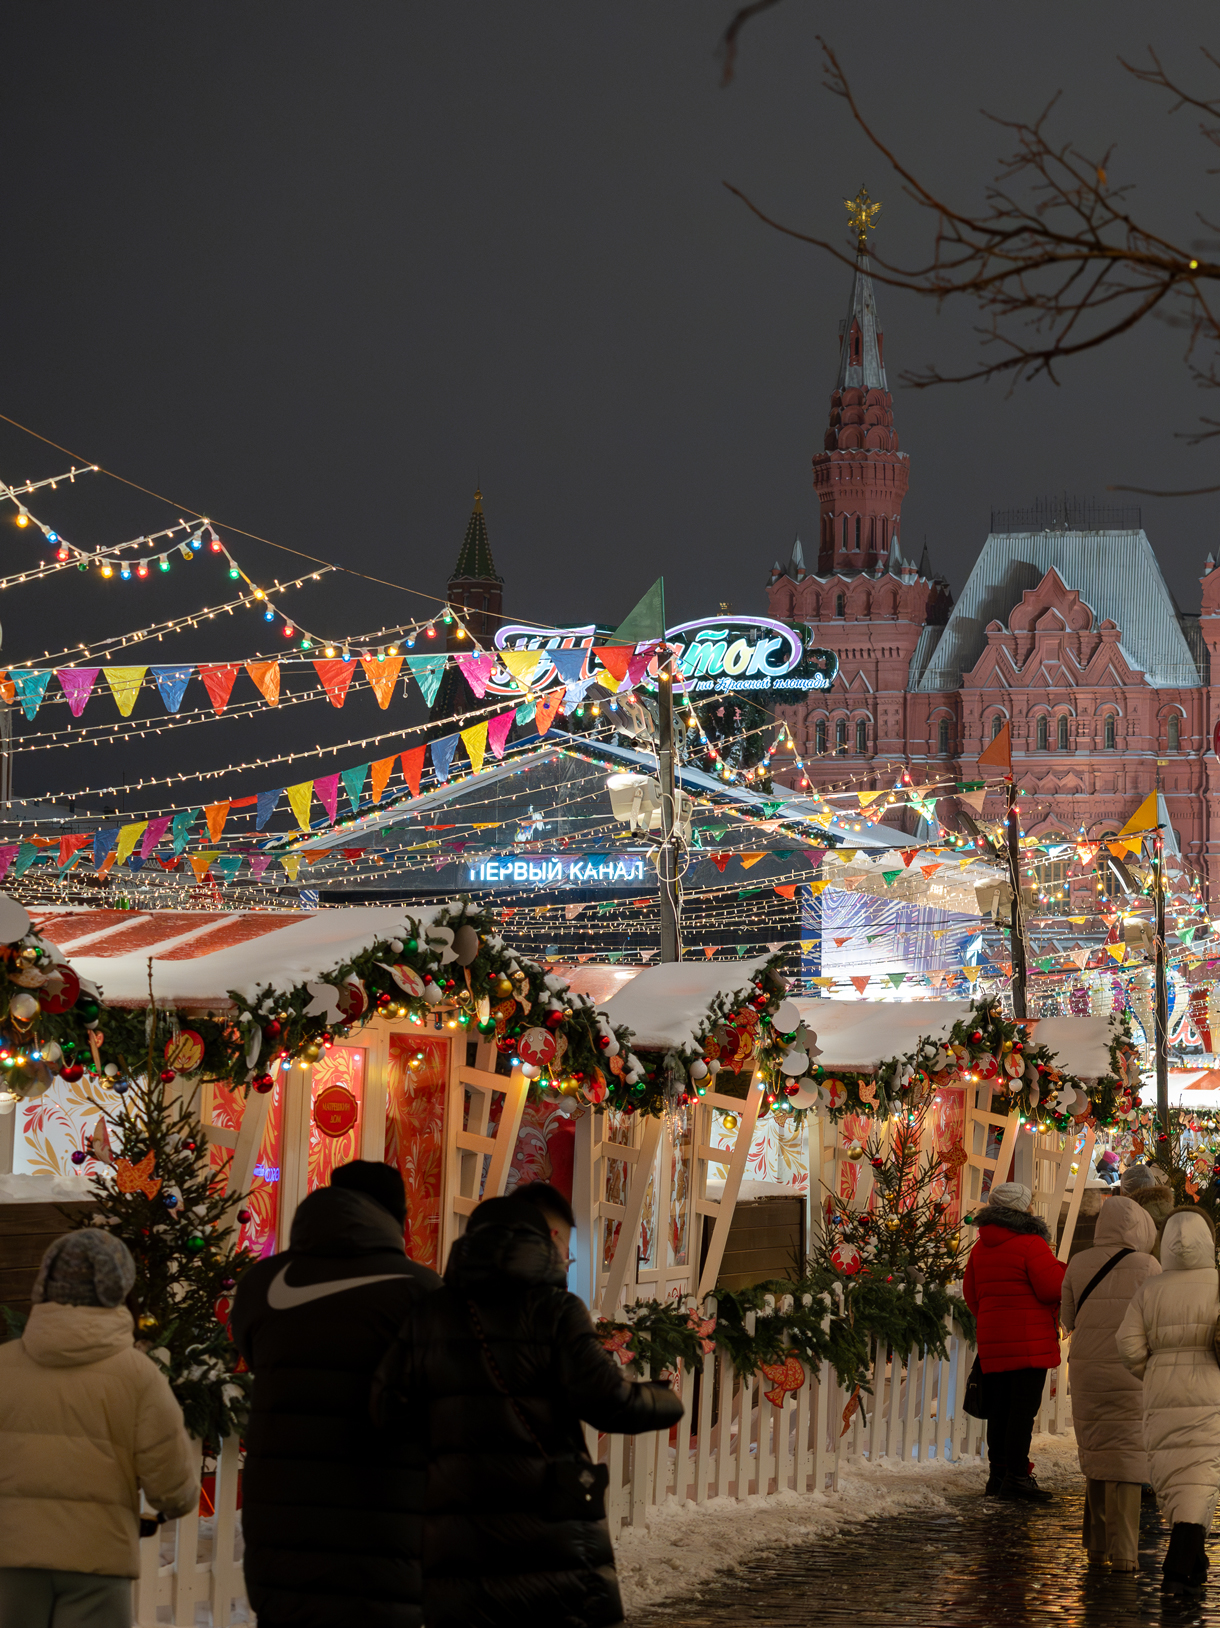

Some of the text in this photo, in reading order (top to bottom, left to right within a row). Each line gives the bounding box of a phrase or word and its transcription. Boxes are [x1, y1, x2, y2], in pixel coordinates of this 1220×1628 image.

[696, 672, 829, 695] на Красной площади
[470, 858, 645, 881] ПЕРВЫЙ КАНАЛ
